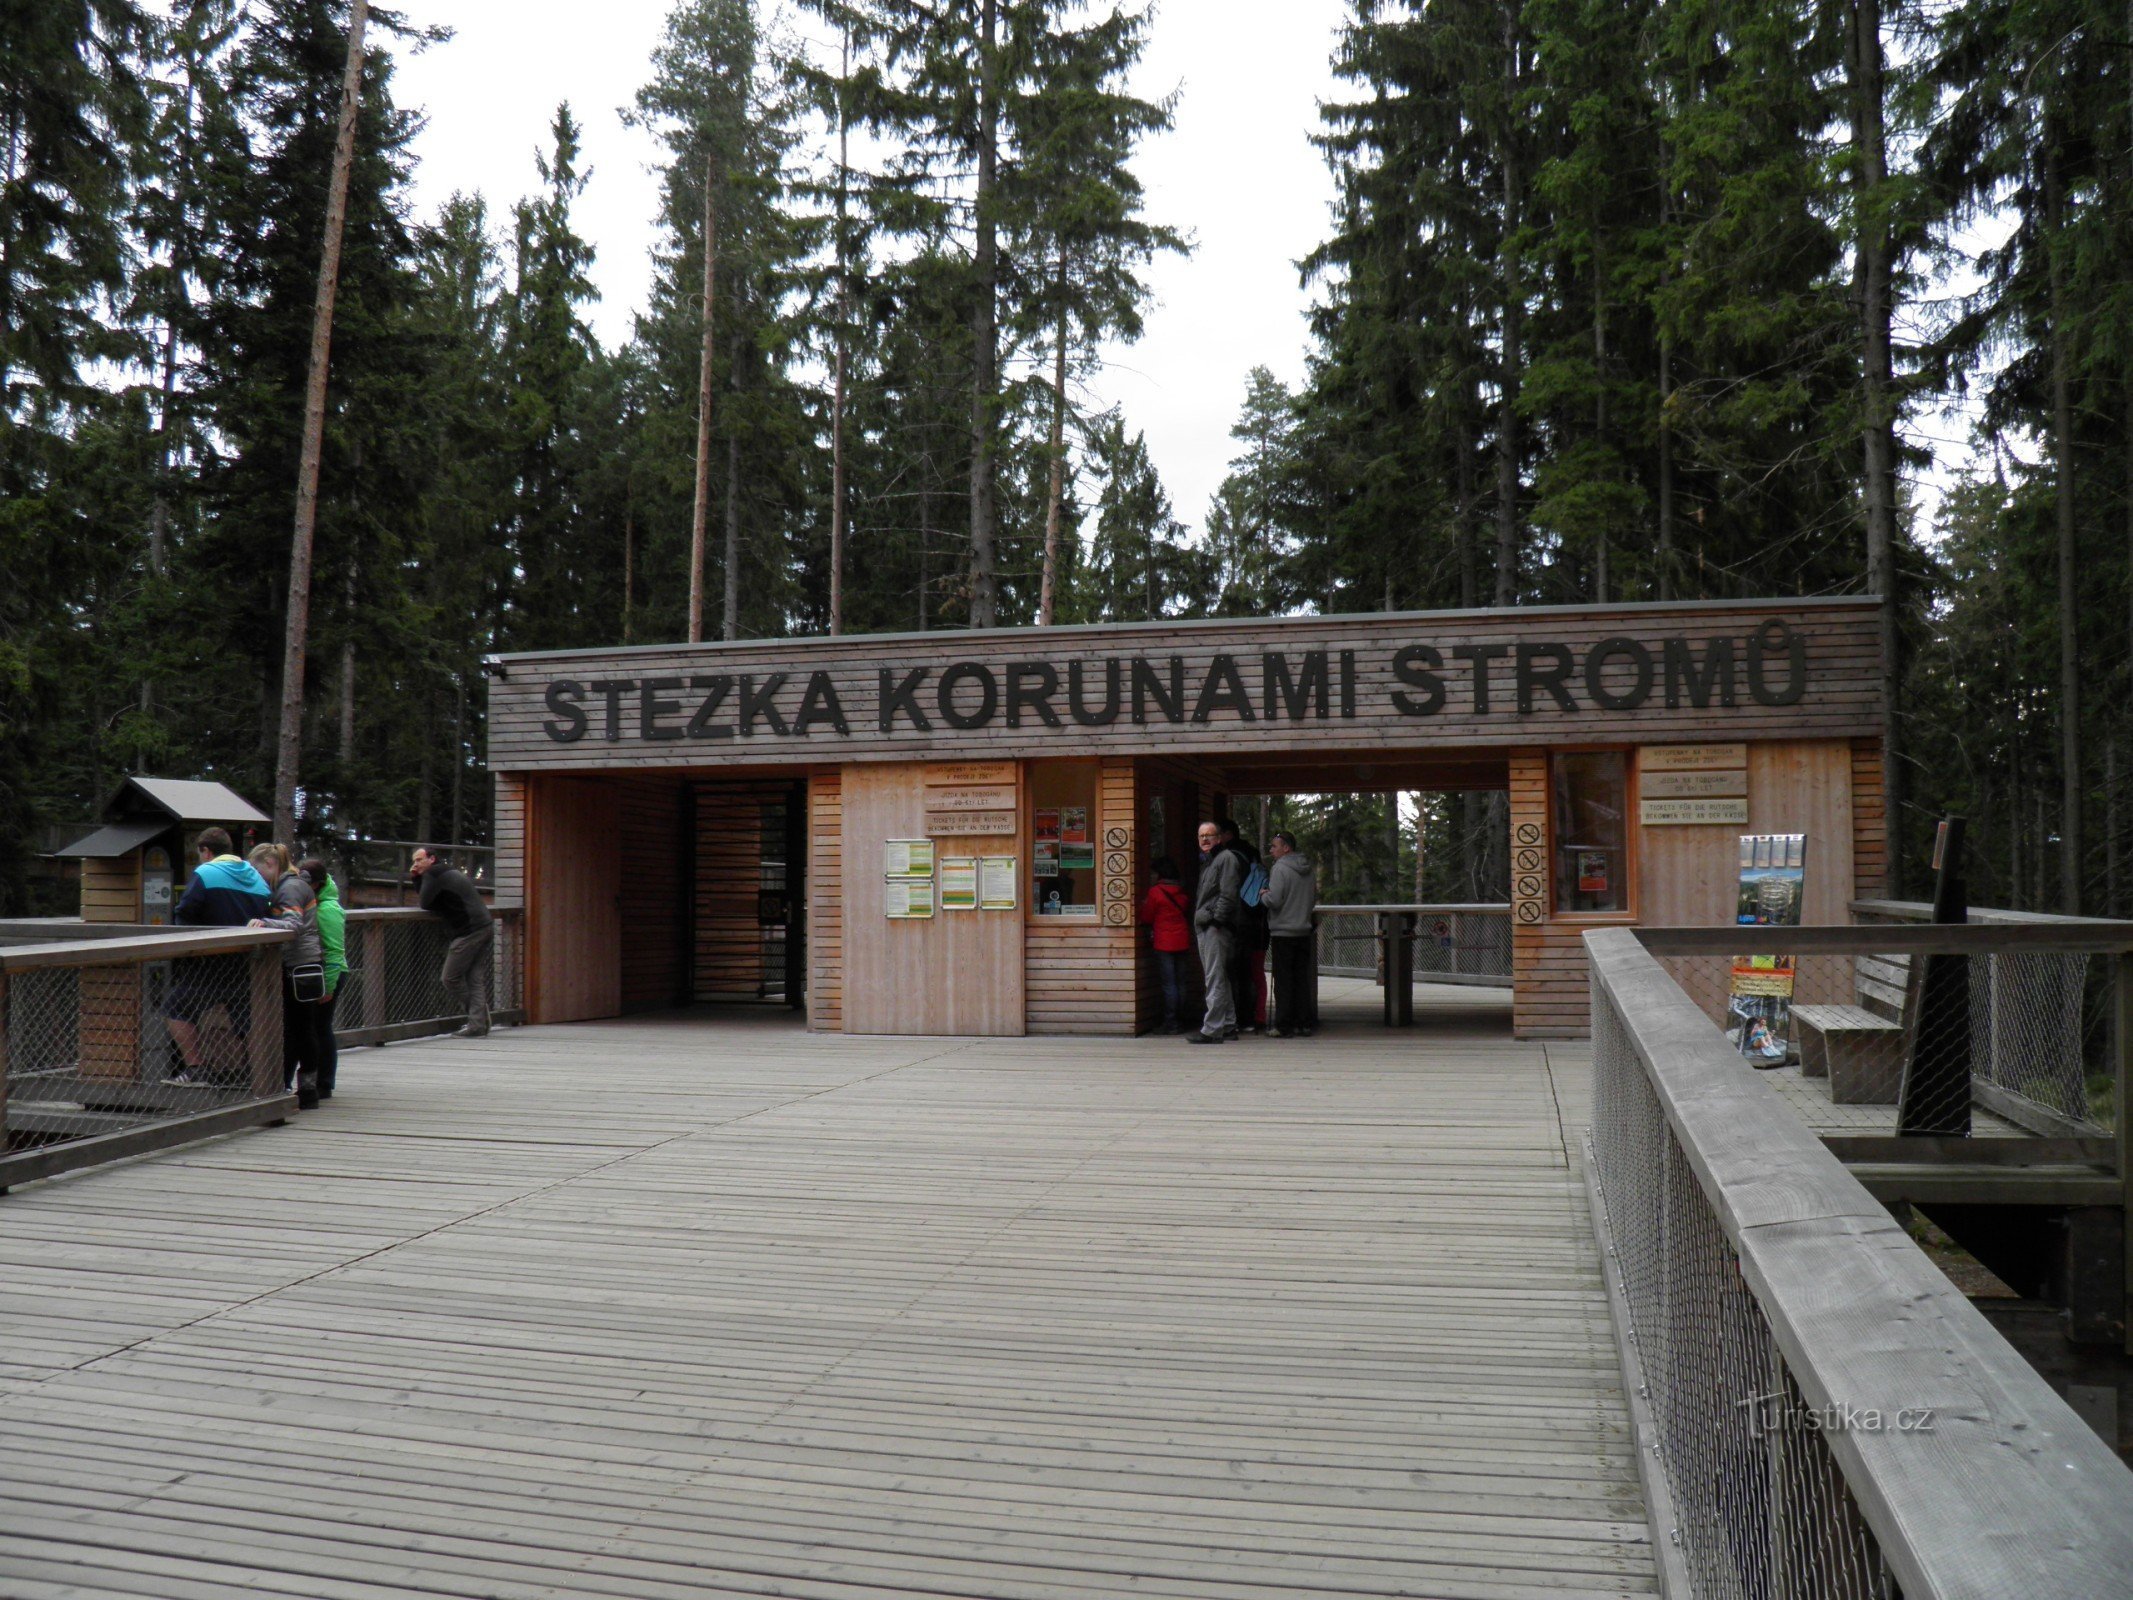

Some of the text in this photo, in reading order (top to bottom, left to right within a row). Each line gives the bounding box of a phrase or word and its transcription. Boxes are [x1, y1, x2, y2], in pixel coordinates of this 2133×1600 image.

[542, 617, 1806, 743] STEZKA KORUNAMI STROMŮ
[1709, 803, 1738, 811] RUTSCHE
[1645, 812, 1678, 820] BEKOMMEN
